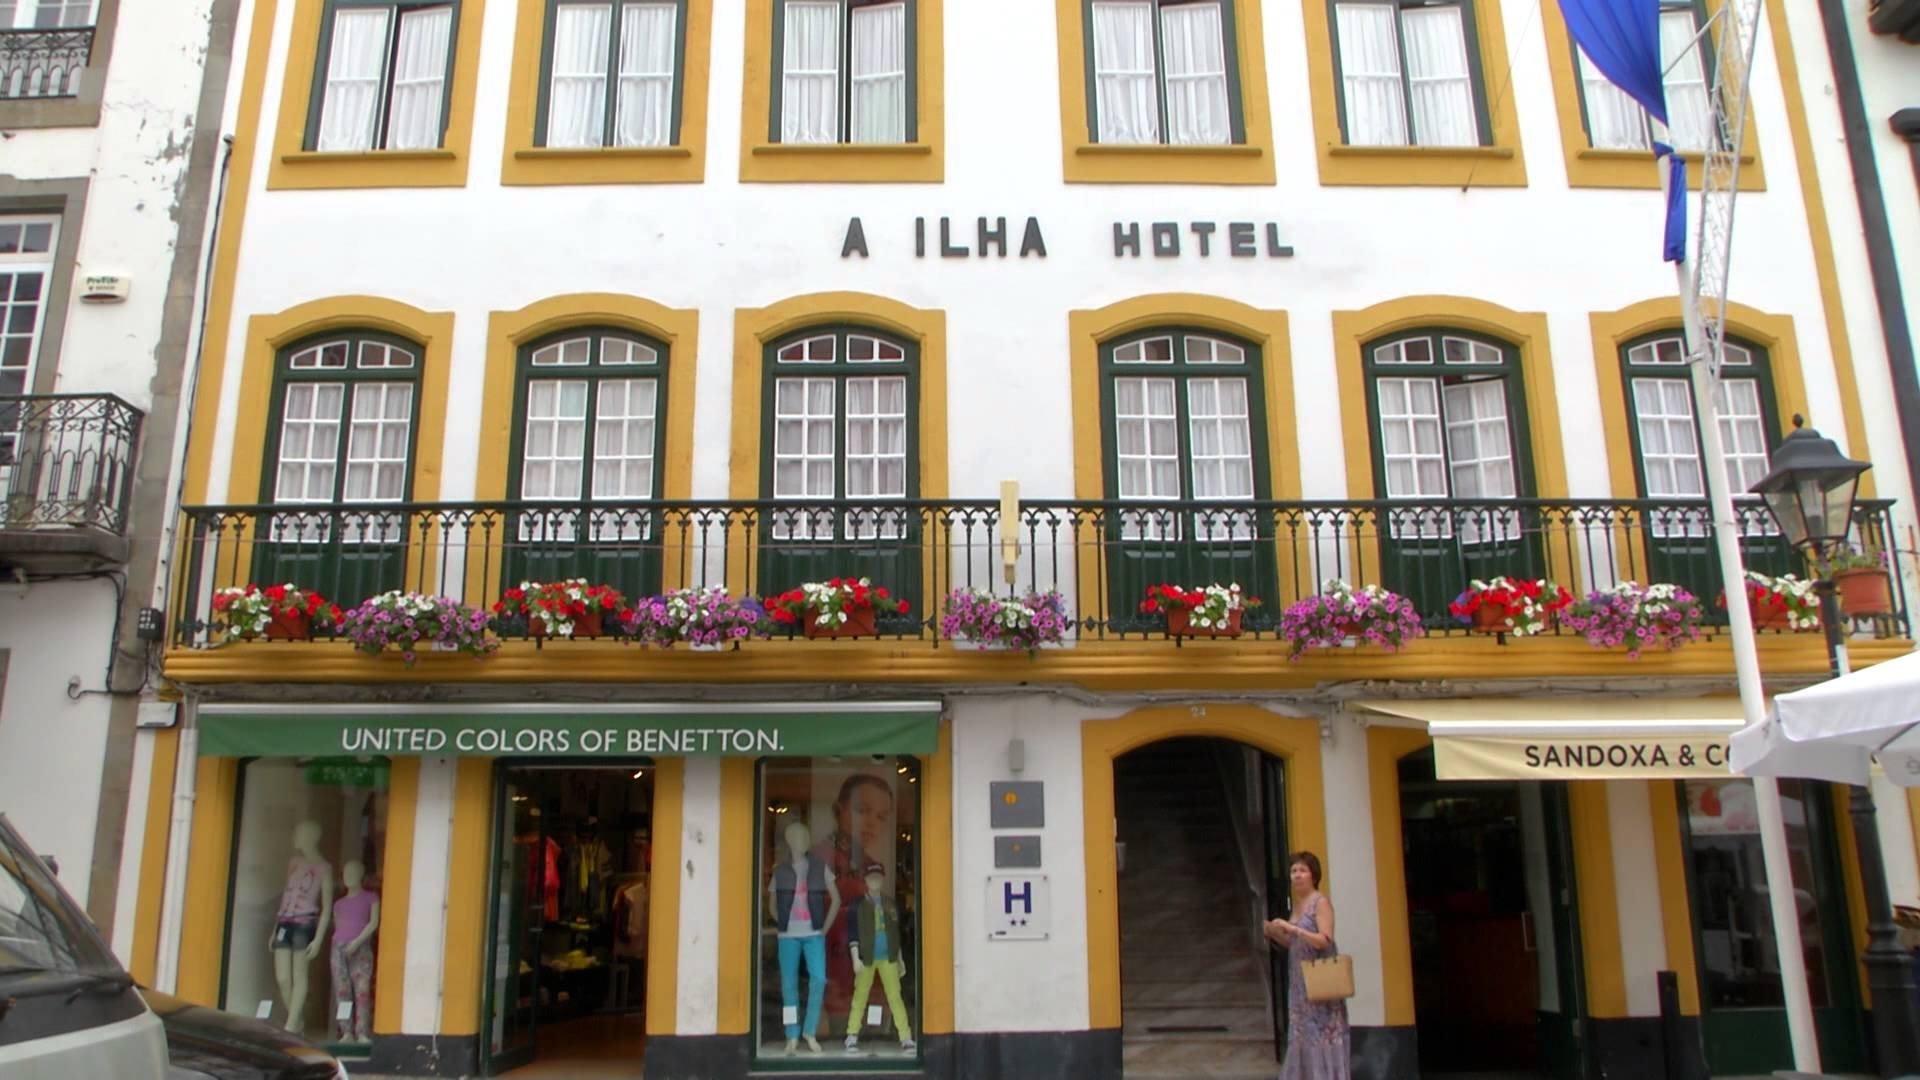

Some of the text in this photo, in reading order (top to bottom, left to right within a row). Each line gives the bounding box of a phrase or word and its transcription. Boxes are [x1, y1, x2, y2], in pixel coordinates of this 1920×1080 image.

[841, 217, 1294, 258] A ILHA HOTEL
[341, 728, 785, 753] UNITED COLORS OF BENETTON.
[1525, 745, 1669, 767] SANDOXA
[1679, 744, 1695, 766] &
[1004, 882, 1032, 914] H
